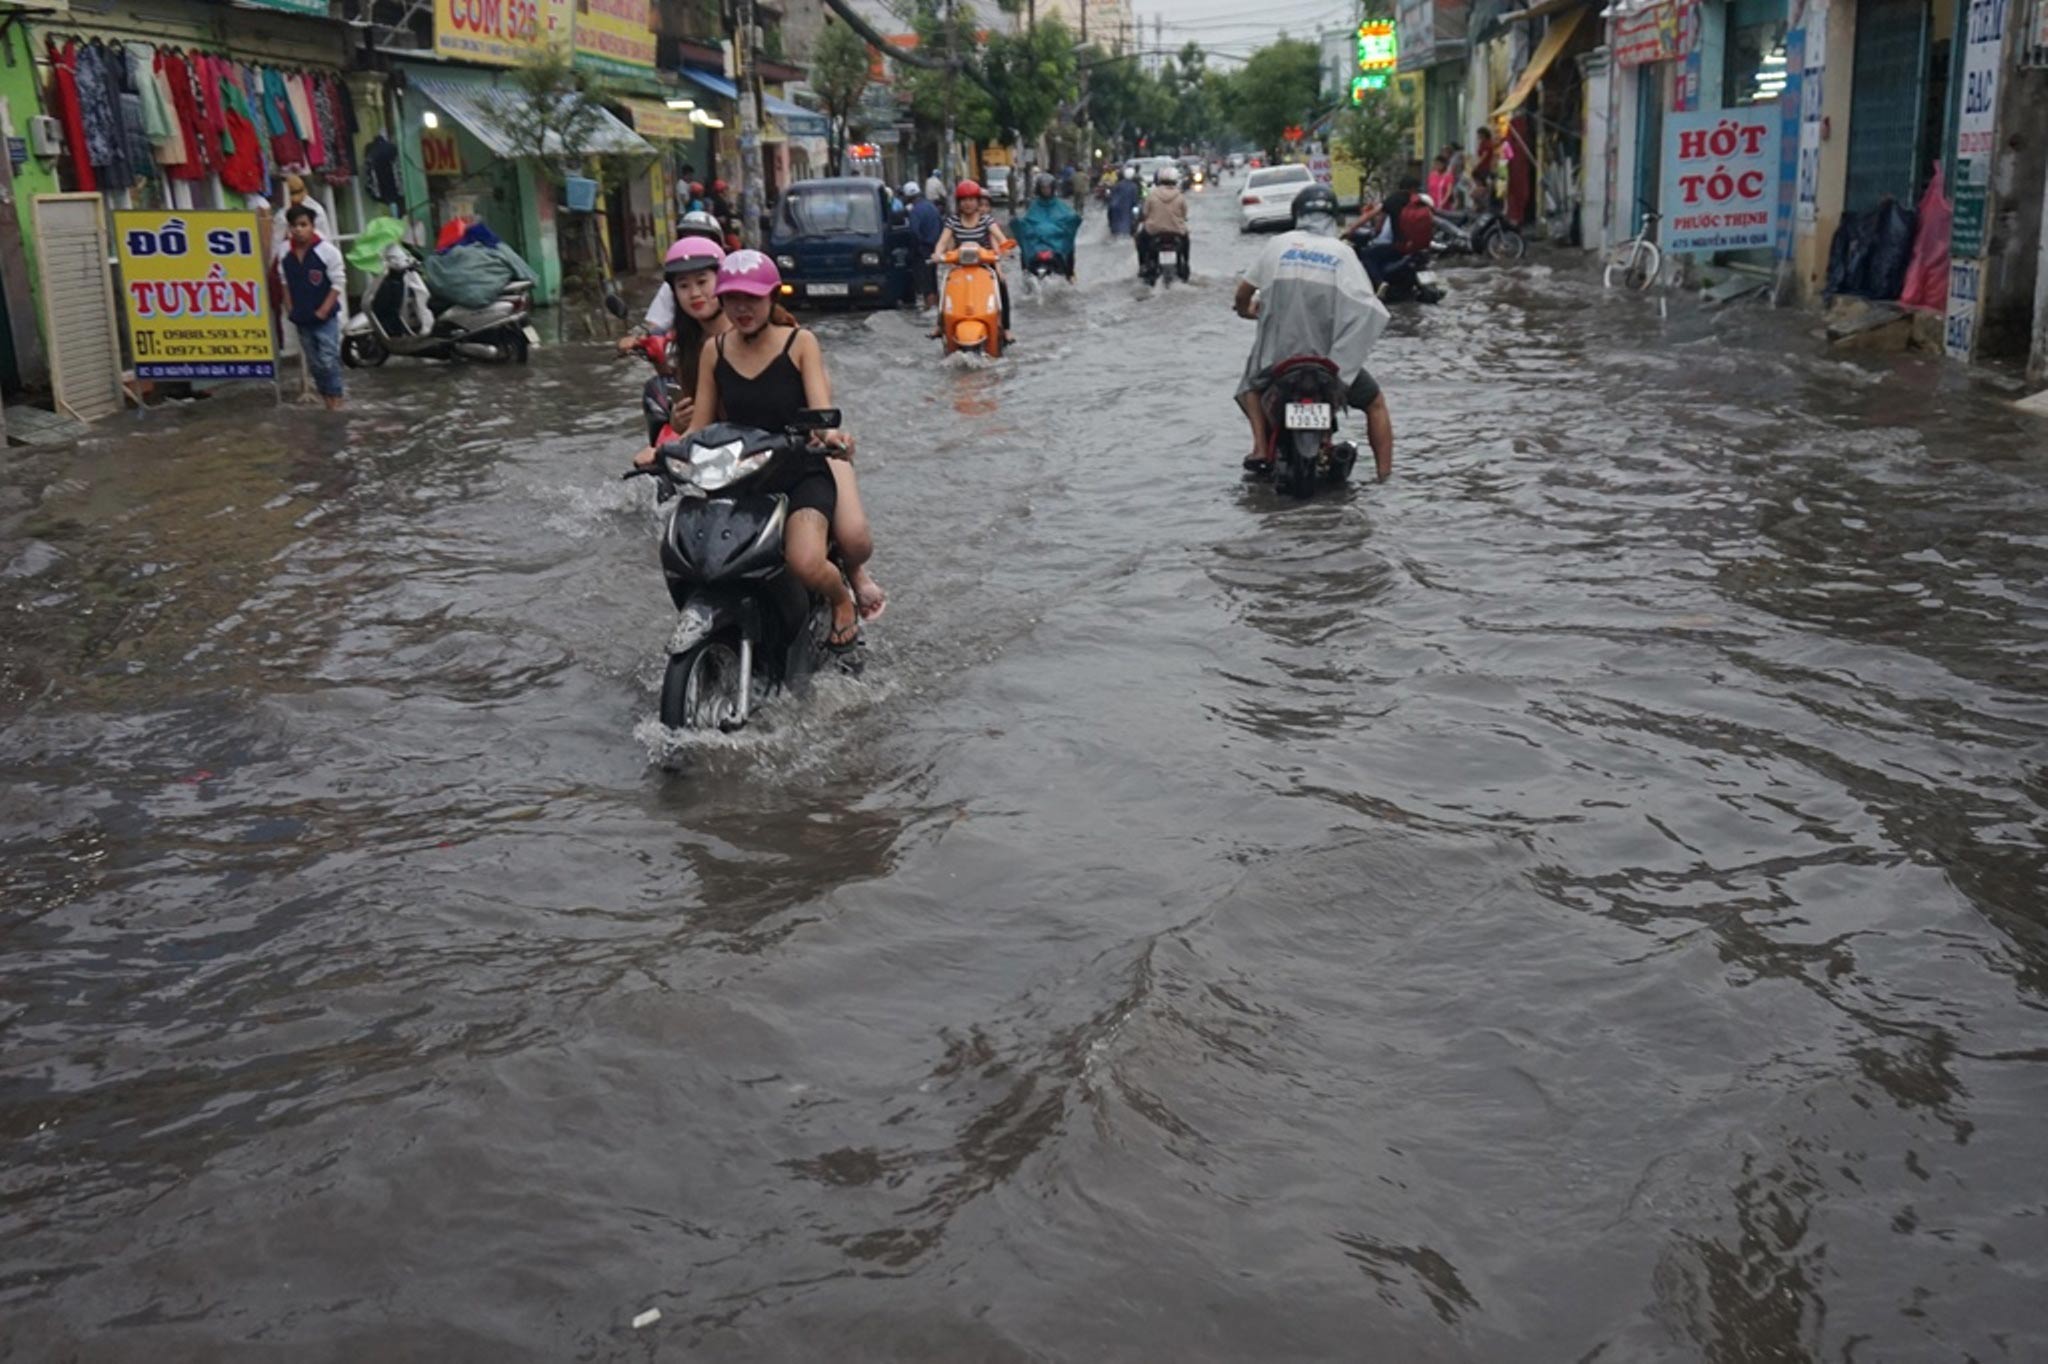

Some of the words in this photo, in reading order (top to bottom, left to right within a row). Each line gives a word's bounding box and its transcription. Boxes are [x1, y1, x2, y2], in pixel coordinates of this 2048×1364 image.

[1678, 119, 1767, 158] HỚT
[1678, 165, 1764, 203] TÓC
[127, 219, 187, 256] ĐỒ
[207, 230, 252, 256] SI
[1724, 211, 1768, 228] THỊNH
[130, 263, 257, 314] TUYỀN
